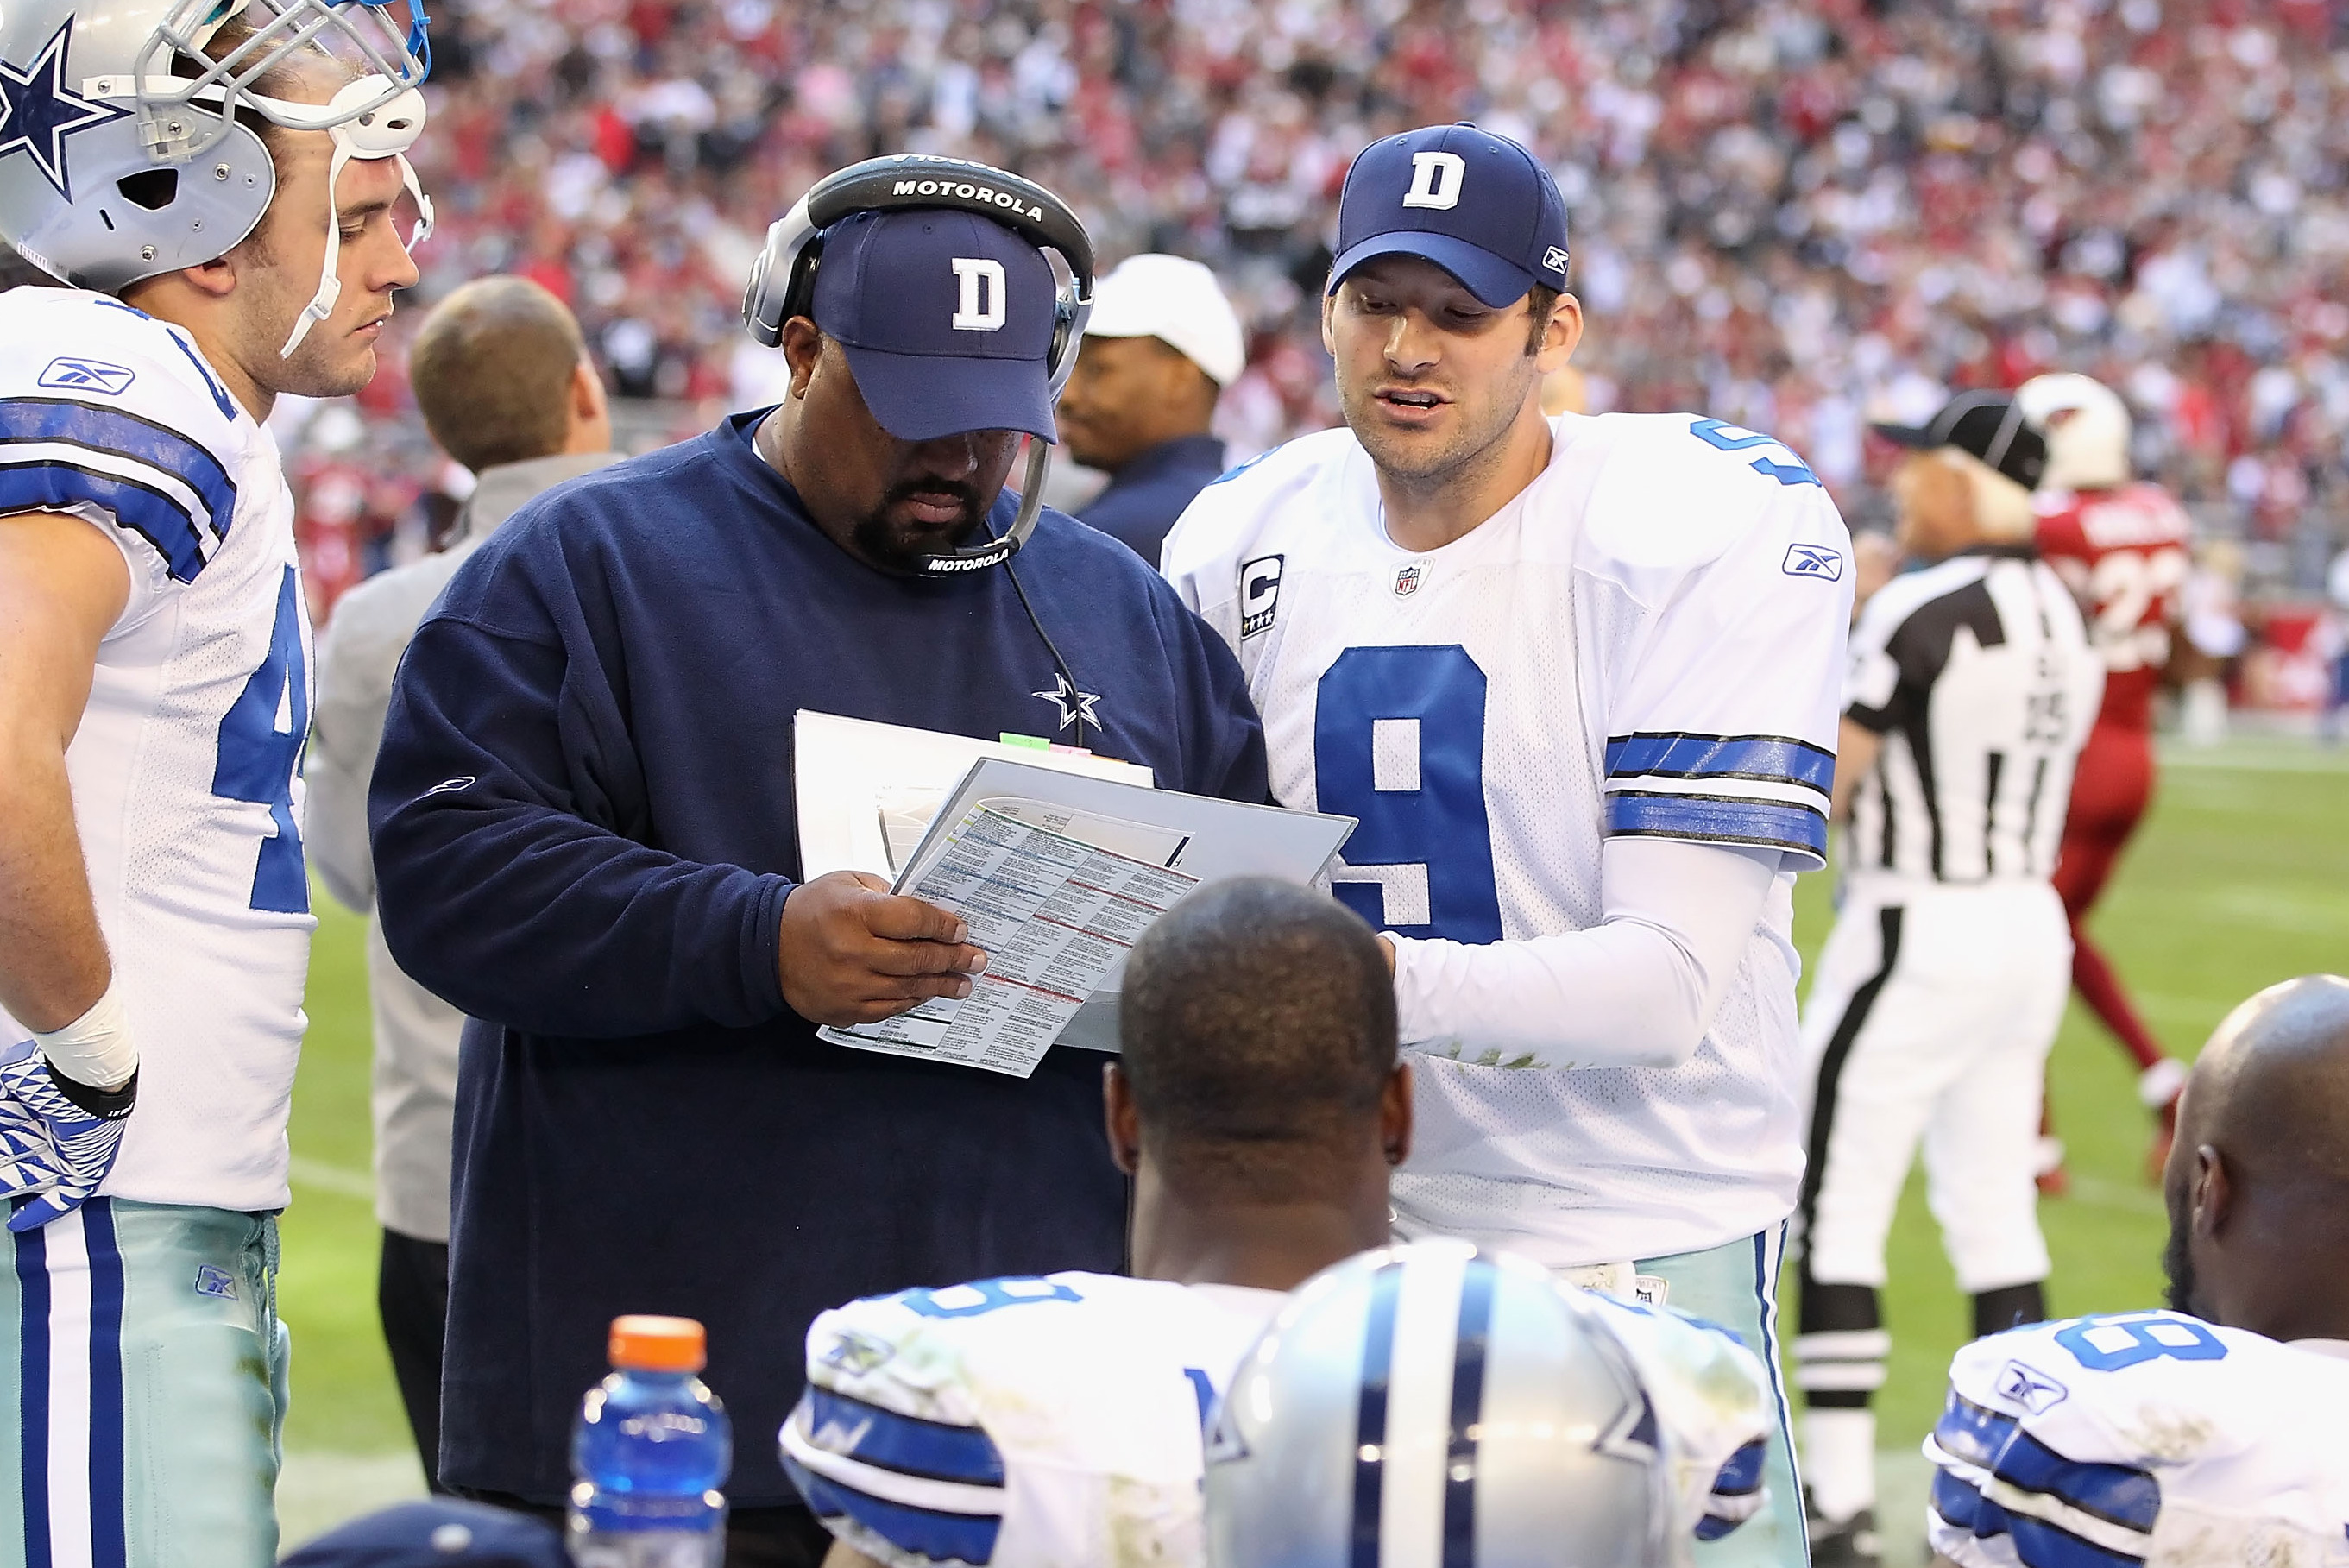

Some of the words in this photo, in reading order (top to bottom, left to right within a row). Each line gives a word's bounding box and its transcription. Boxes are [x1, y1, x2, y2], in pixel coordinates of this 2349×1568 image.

[892, 180, 1043, 222] MOTOROLA
[1402, 151, 1466, 211] D
[952, 258, 1007, 332] D
[928, 548, 1009, 572] MOTOROLA
[1242, 557, 1282, 619] C
[1397, 577, 1418, 593] NFL
[1313, 644, 1504, 946] 9
